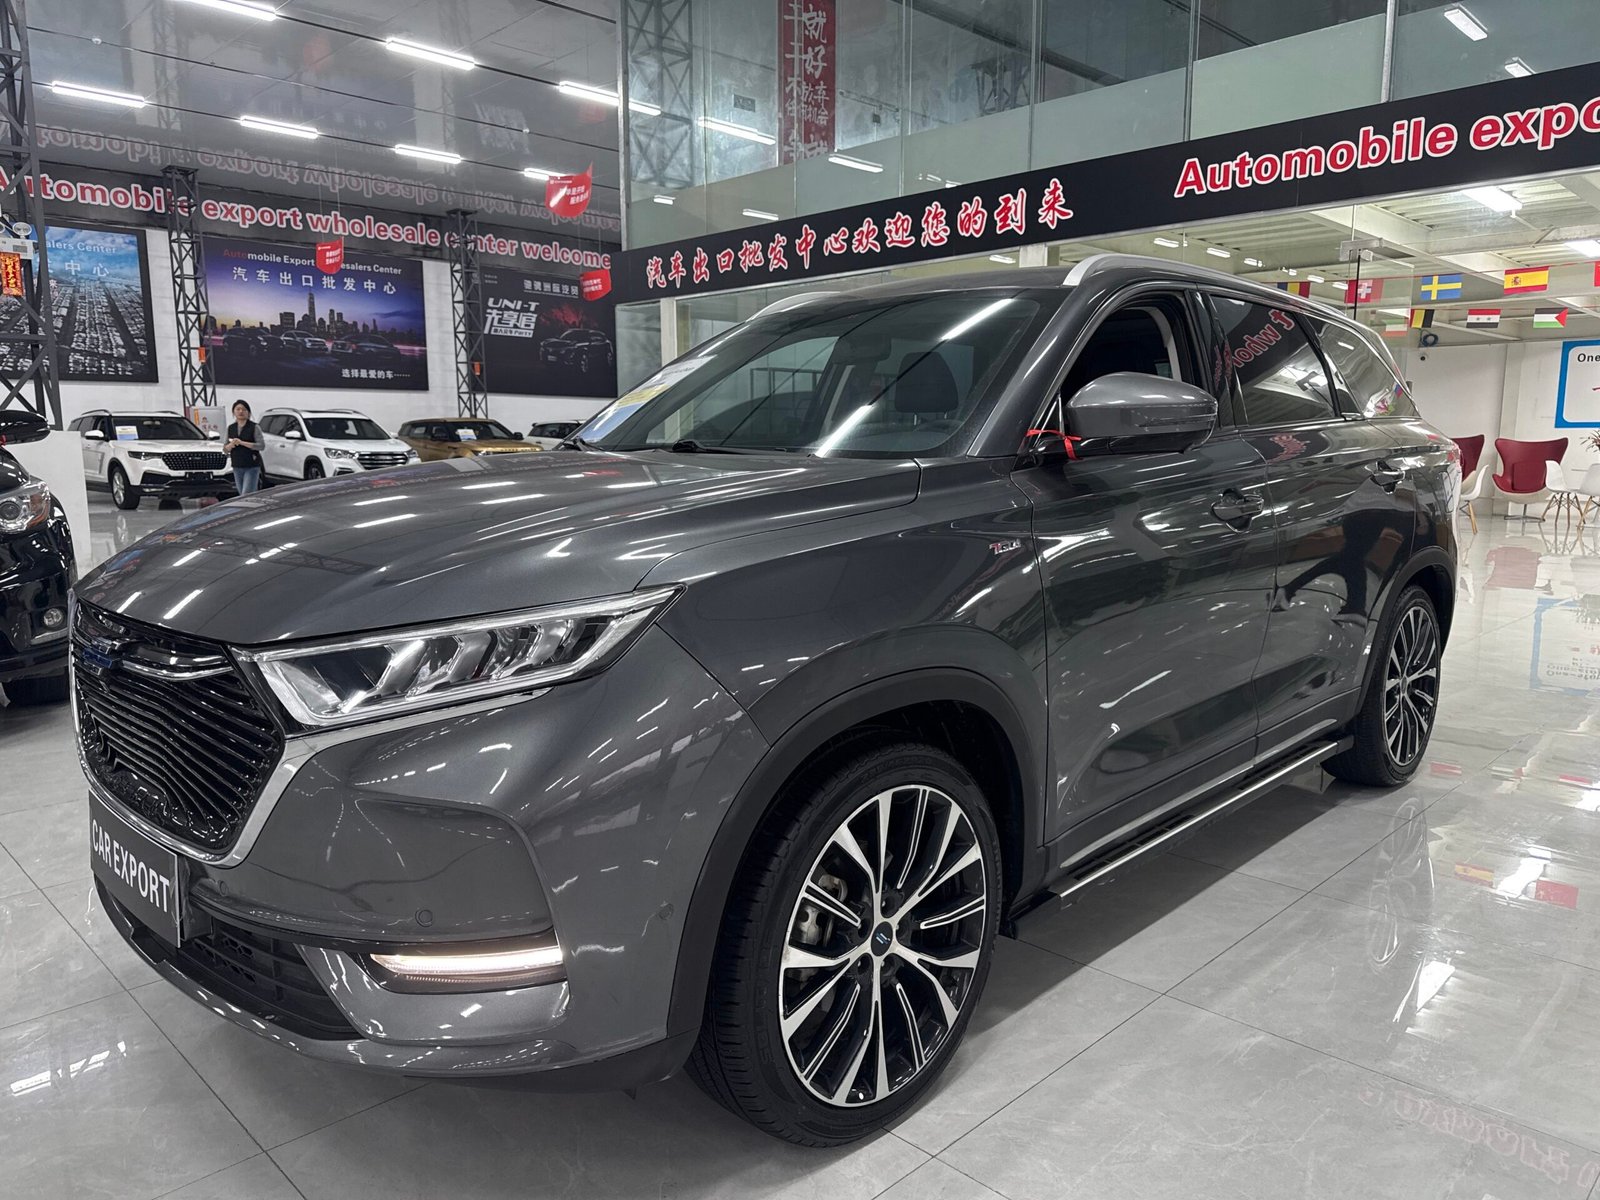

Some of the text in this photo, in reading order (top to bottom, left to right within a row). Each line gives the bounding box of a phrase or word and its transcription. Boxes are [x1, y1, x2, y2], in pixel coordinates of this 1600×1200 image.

[1174, 115, 1457, 198] Automobile
[77, 243, 117, 254] Center
[201, 200, 303, 229] export
[306, 210, 440, 245] wholesale
[444, 231, 518, 257] cnter
[521, 242, 612, 269] welcome
[646, 177, 1075, 289] 汽车出口批发中心欢迎您的到来
[223, 248, 282, 264] Automobile
[284, 255, 316, 268] Export
[341, 261, 372, 272] esalers
[373, 264, 402, 275] Center
[232, 266, 397, 295] 汽车出口批发中心
[488, 297, 540, 312] UNI-T
[92, 819, 170, 913] CAR EXPORT
